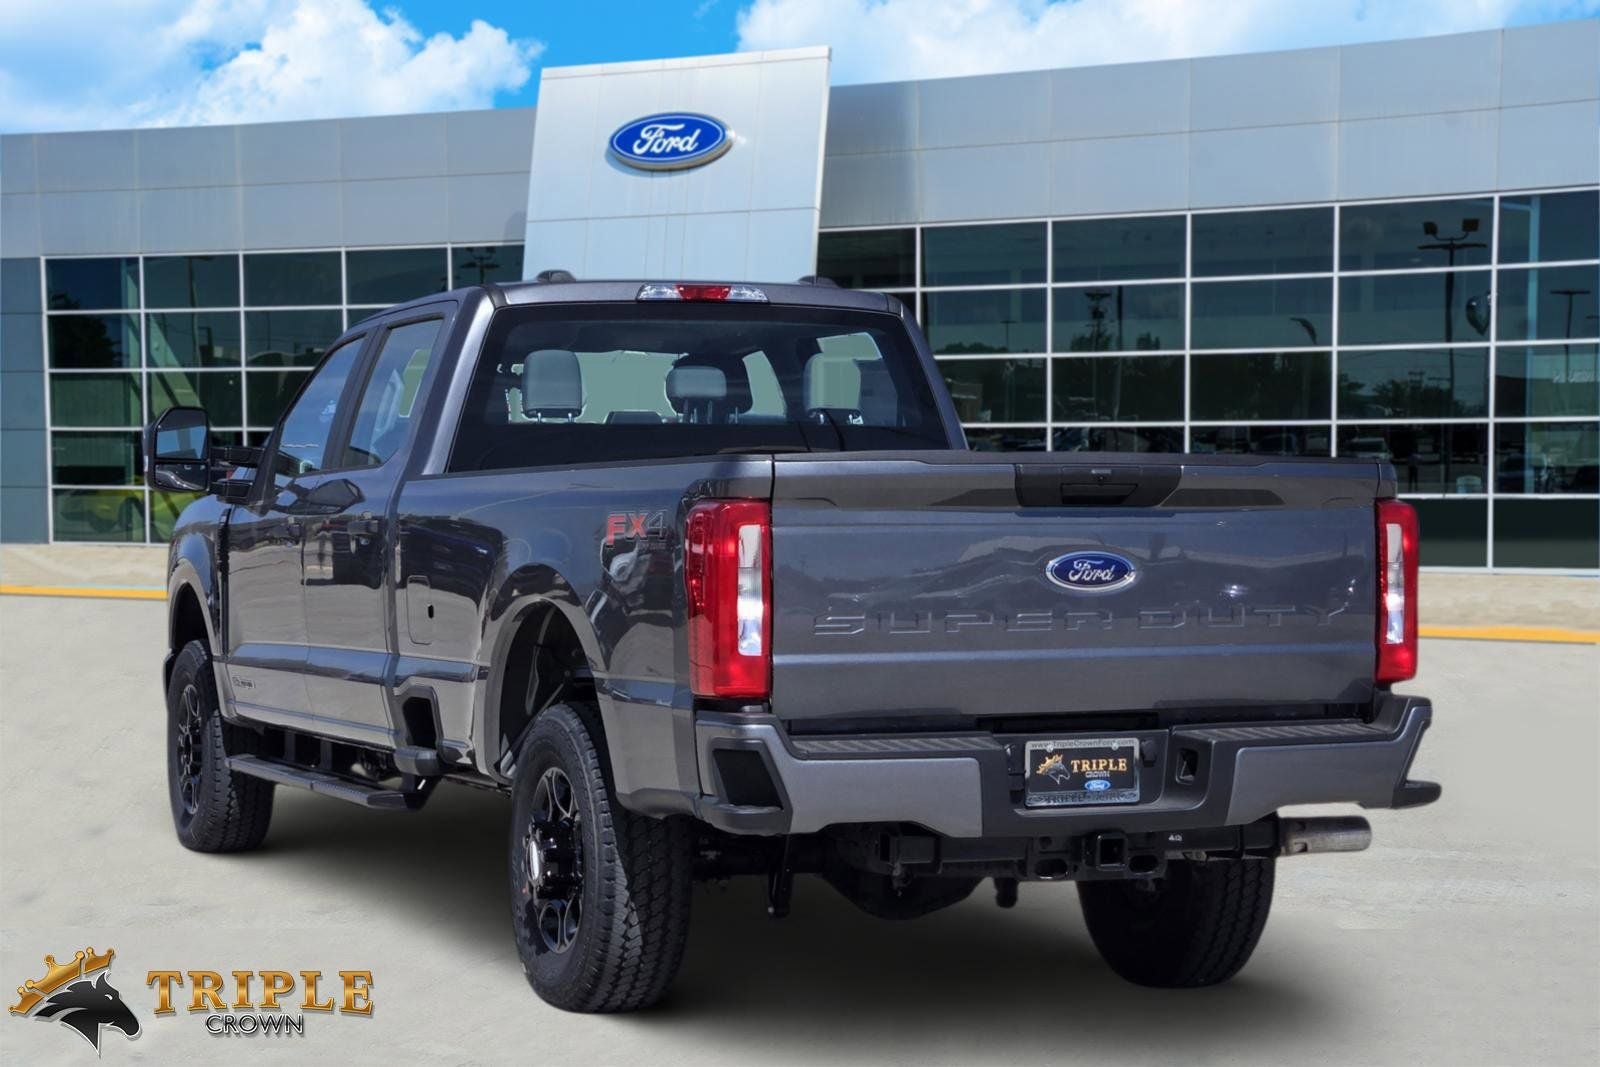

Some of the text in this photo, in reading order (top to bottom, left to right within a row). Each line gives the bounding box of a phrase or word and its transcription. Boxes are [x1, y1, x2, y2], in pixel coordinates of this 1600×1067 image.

[632, 123, 702, 155] Ford
[606, 510, 668, 546] FX4
[1068, 559, 1116, 581] Ford
[814, 601, 1350, 637] SUPER DUTY
[1070, 758, 1128, 773] TRIPLE
